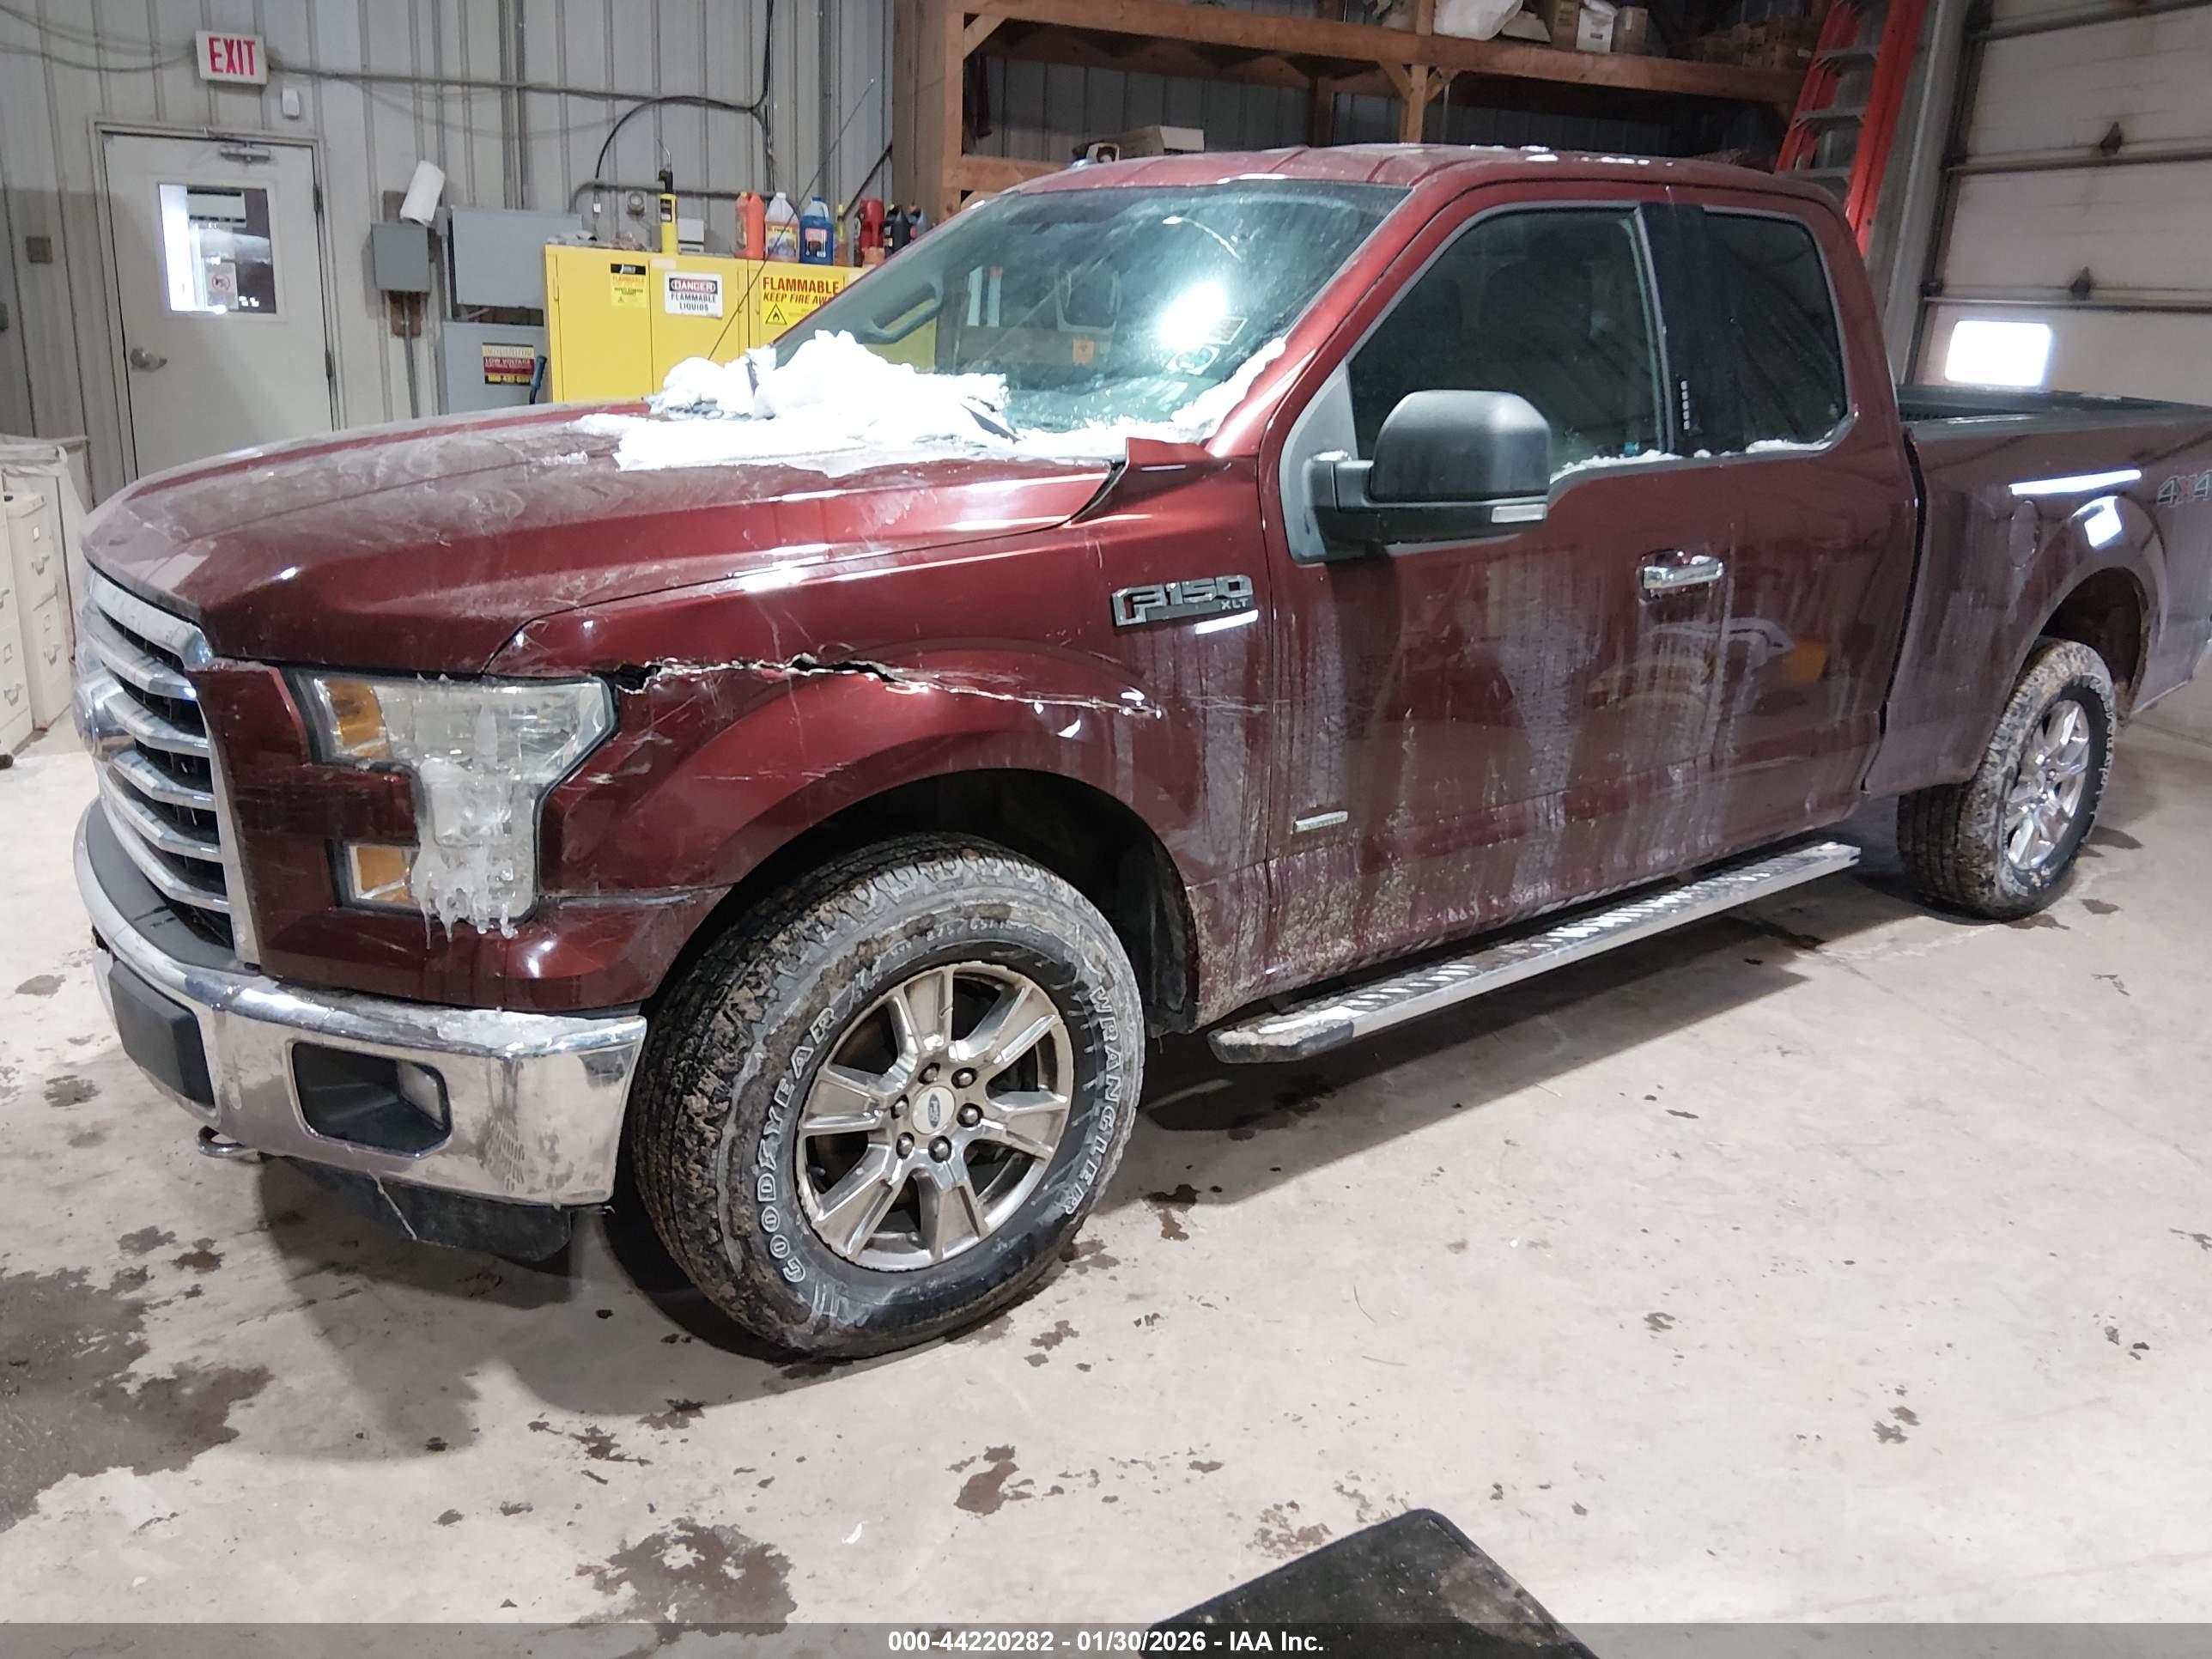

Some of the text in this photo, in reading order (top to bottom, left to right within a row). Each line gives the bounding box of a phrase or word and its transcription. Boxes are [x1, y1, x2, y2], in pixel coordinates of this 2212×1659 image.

[208, 37, 256, 76] EXIT
[674, 281, 712, 292] DANGER
[763, 276, 839, 295] FLAMMABLE
[671, 294, 715, 303] FLAMMABLE
[763, 292, 787, 302] KEEP
[789, 295, 810, 304] FIRE
[679, 302, 708, 311] LIQUIDS
[1221, 599, 1249, 611] XLT
[1066, 986, 1123, 1215] WRANGLER
[757, 1006, 836, 1282] GOODYEAR
